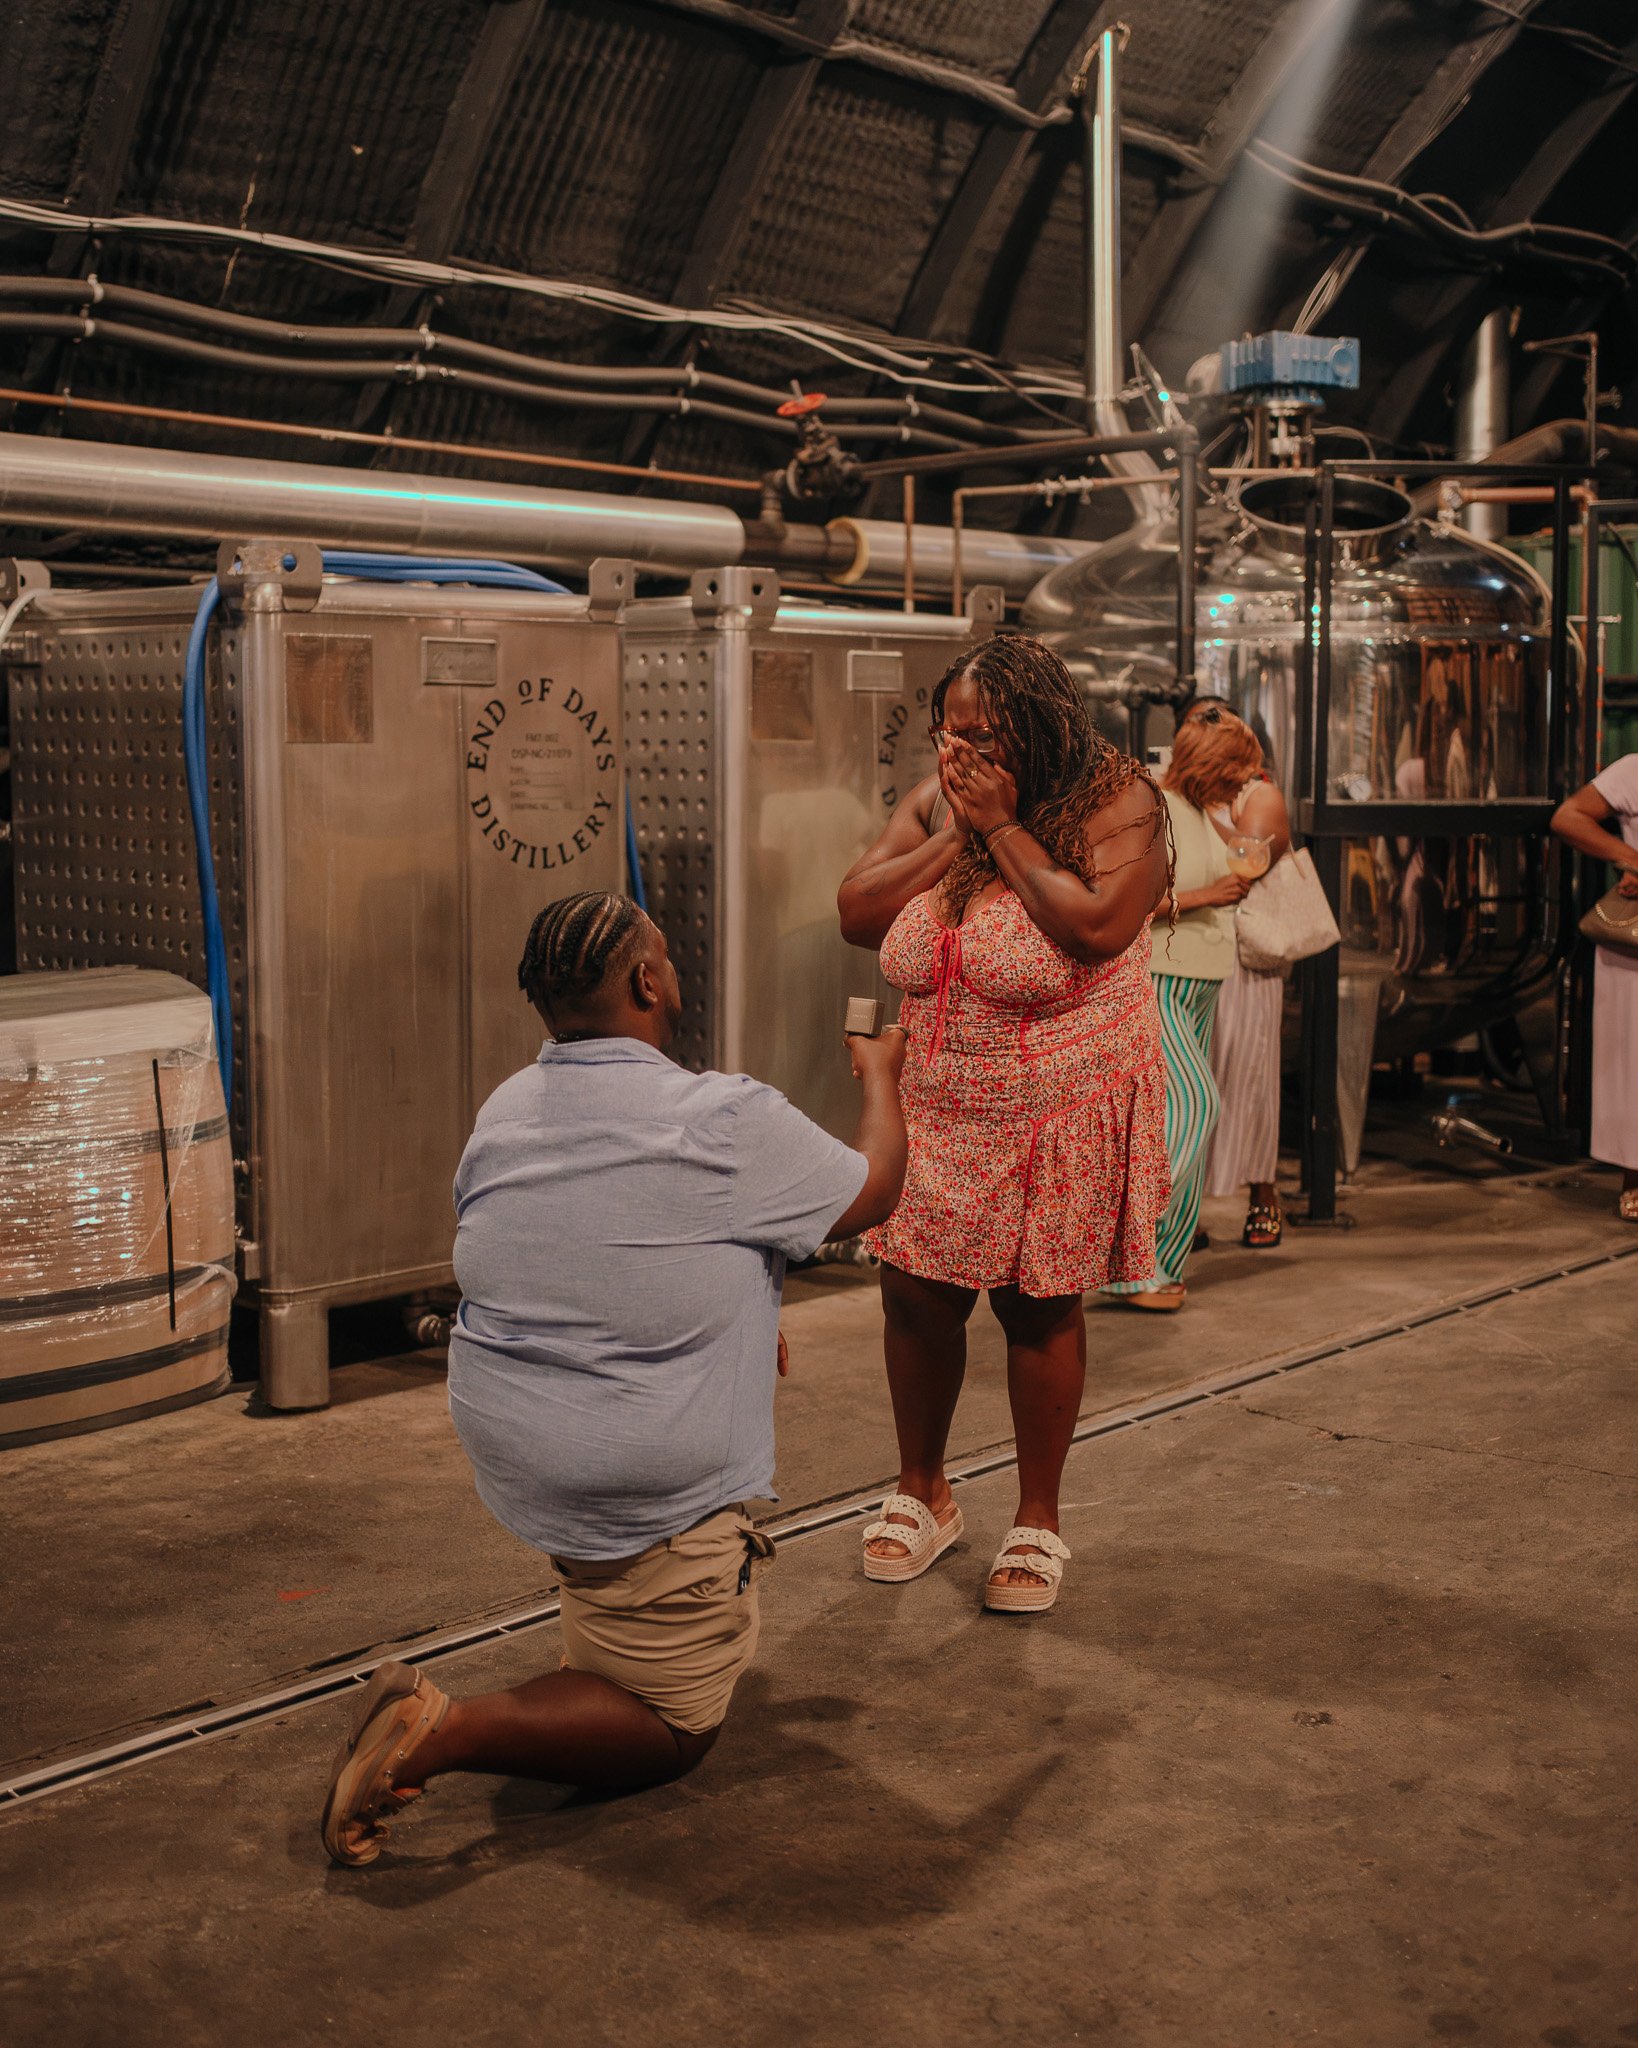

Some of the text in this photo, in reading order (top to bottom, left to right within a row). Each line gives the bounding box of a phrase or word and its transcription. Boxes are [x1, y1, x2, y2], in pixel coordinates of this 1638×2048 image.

[467, 699, 507, 773] END
[562, 687, 616, 772] DAYS
[879, 705, 908, 766] END
[470, 792, 613, 870] DISTILLERY
